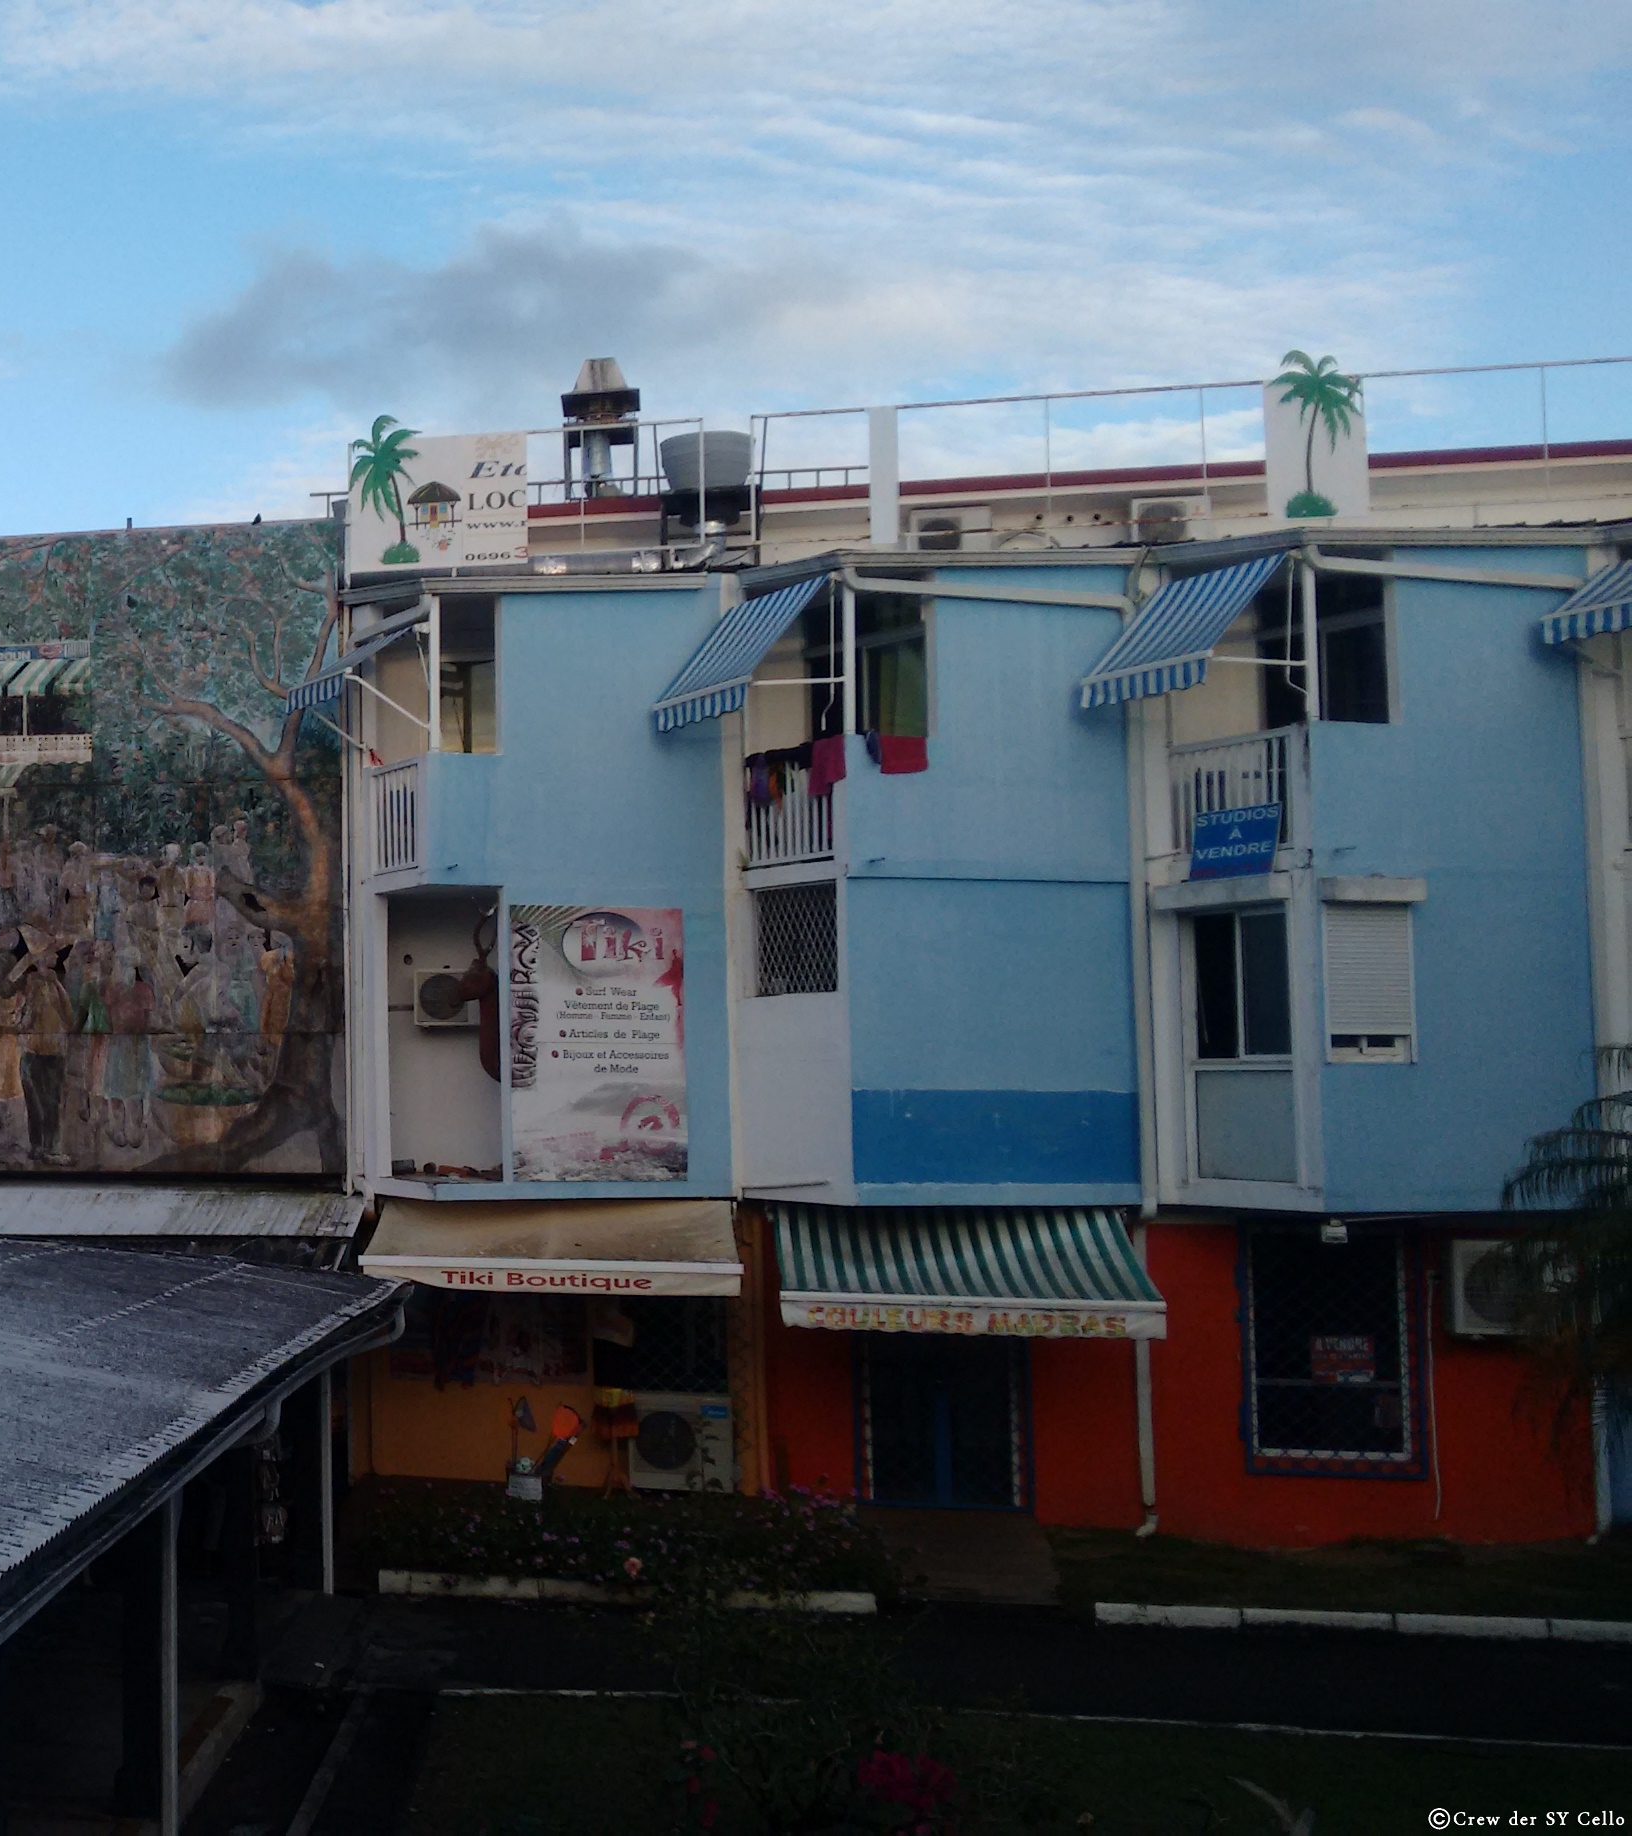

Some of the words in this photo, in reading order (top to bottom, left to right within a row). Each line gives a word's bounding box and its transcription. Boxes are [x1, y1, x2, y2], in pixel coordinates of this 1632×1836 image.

[468, 489, 526, 510] LOC
[465, 551, 510, 561] 0696
[1197, 806, 1279, 827] STUDIOS
[1195, 842, 1272, 859] VENDRE
[573, 919, 665, 962] Tiki
[586, 987, 607, 996] Surf
[611, 988, 637, 997] Wear
[564, 1000, 613, 1010] Vêtement
[615, 1001, 629, 1010] de
[631, 1001, 660, 1012] Plage
[569, 1029, 609, 1039] Articles
[613, 1030, 627, 1039] de
[632, 1030, 660, 1041] Plage
[563, 1049, 594, 1061] Bijoux
[597, 1050, 607, 1059] et
[609, 1050, 670, 1060] Accessoires
[594, 1064, 608, 1074] de
[609, 1064, 639, 1074] Mode
[441, 1271, 493, 1285] Tiki
[507, 1272, 653, 1291] Boutique
[806, 1306, 974, 1333] COULEURS
[987, 1312, 1127, 1337] MADRAS
